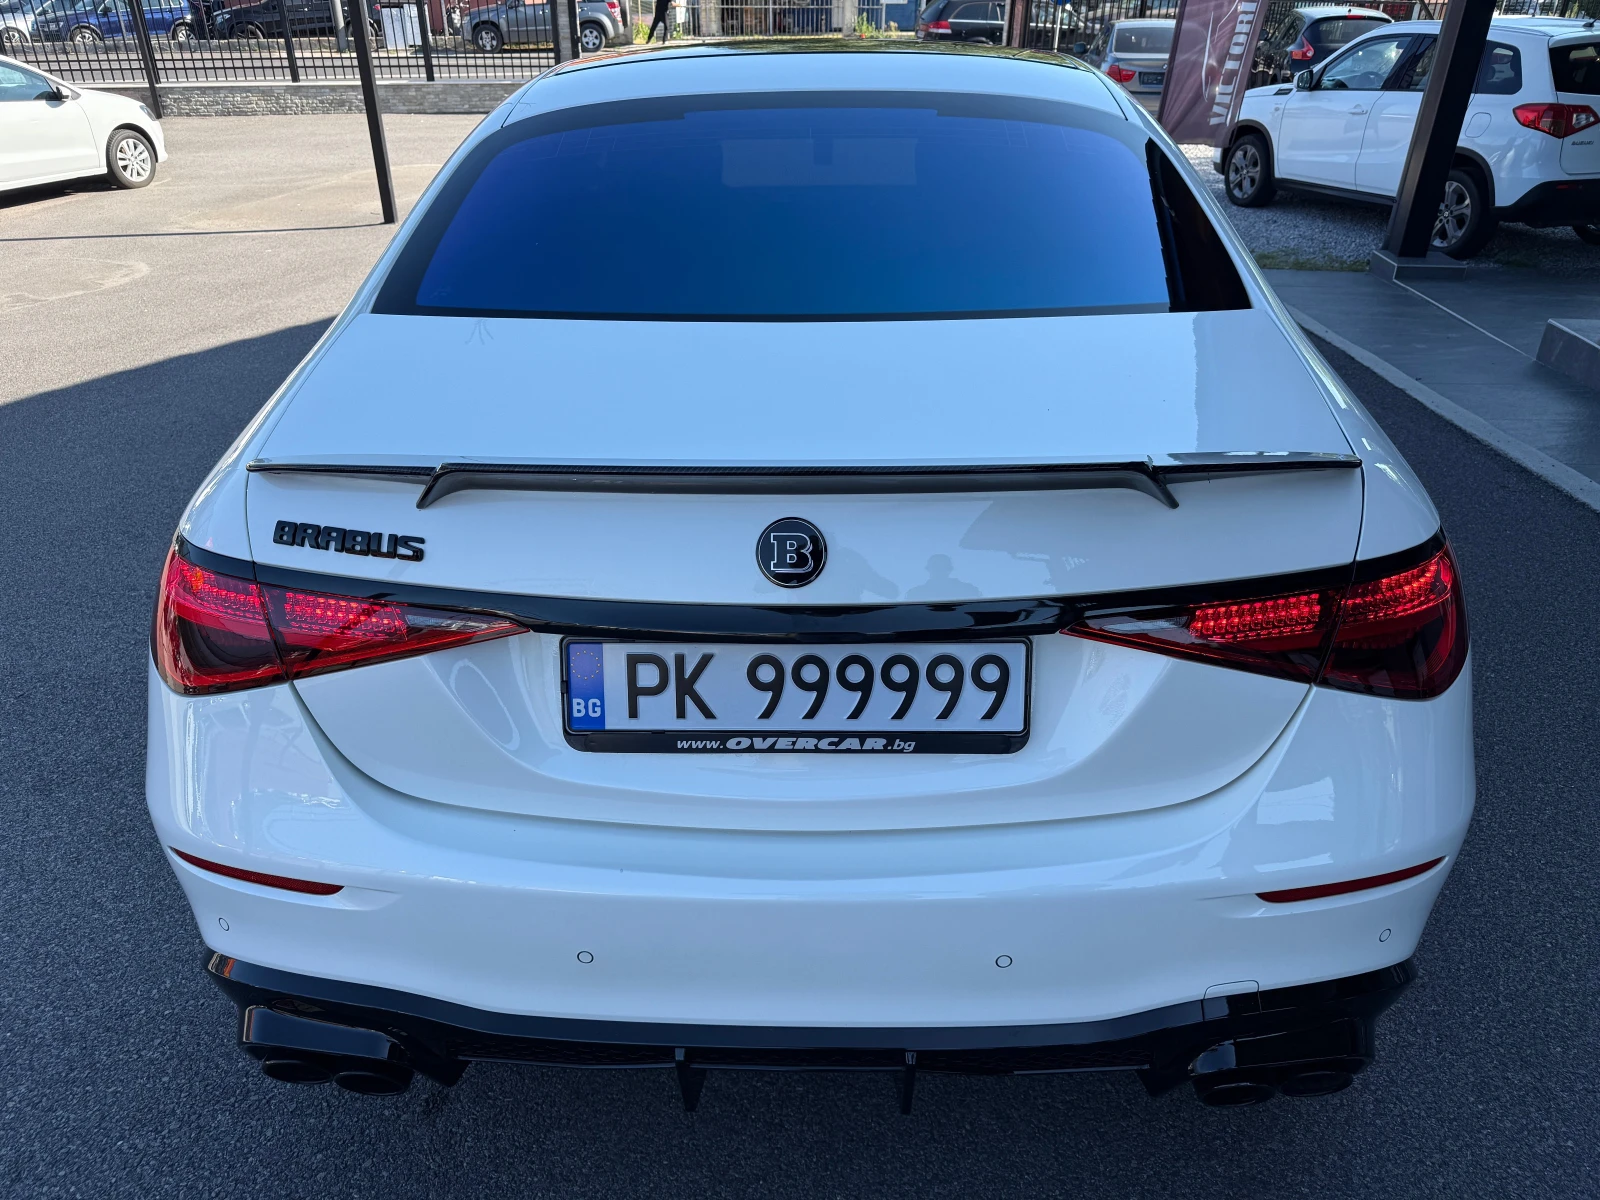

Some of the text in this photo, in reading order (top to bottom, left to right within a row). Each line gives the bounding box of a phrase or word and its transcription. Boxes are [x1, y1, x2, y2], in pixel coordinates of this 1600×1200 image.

[272, 520, 425, 562] BRABUS
[769, 532, 814, 574] B
[625, 653, 1011, 720] PK 999999
[572, 698, 602, 718] BG
[676, 737, 916, 753] www.OVERCAR.bg
